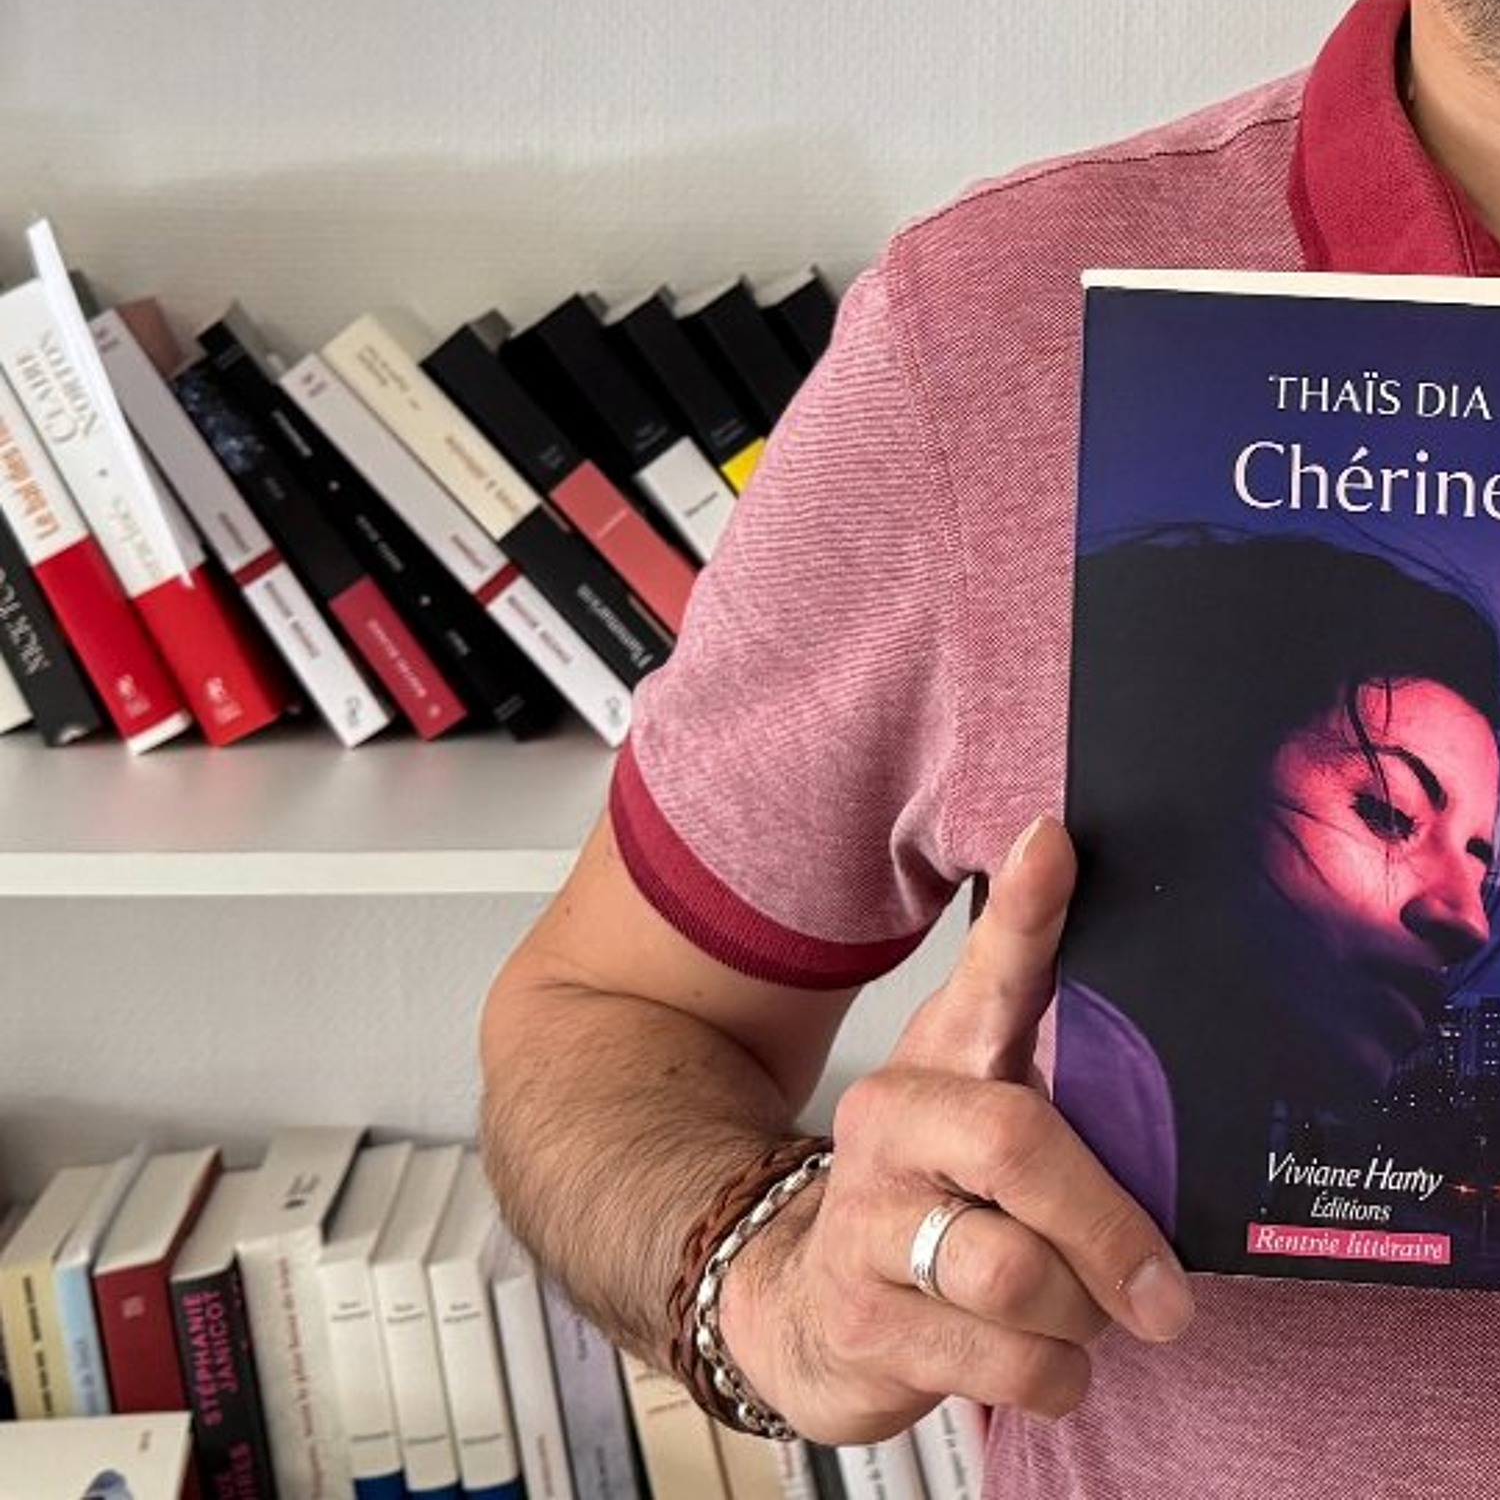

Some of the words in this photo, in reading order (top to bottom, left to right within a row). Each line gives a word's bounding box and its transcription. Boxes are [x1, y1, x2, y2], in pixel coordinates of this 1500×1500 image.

[1271, 371, 1402, 415] THAÏS
[1416, 382, 1493, 421] DIA
[1267, 1152, 1361, 1189] Viviane
[1363, 1157, 1445, 1201] Hamy
[1310, 1190, 1393, 1222] Éditions
[1255, 1226, 1341, 1254] Rentrée
[1346, 1232, 1444, 1260] littéraire
[201, 1290, 238, 1392] JANICOT
